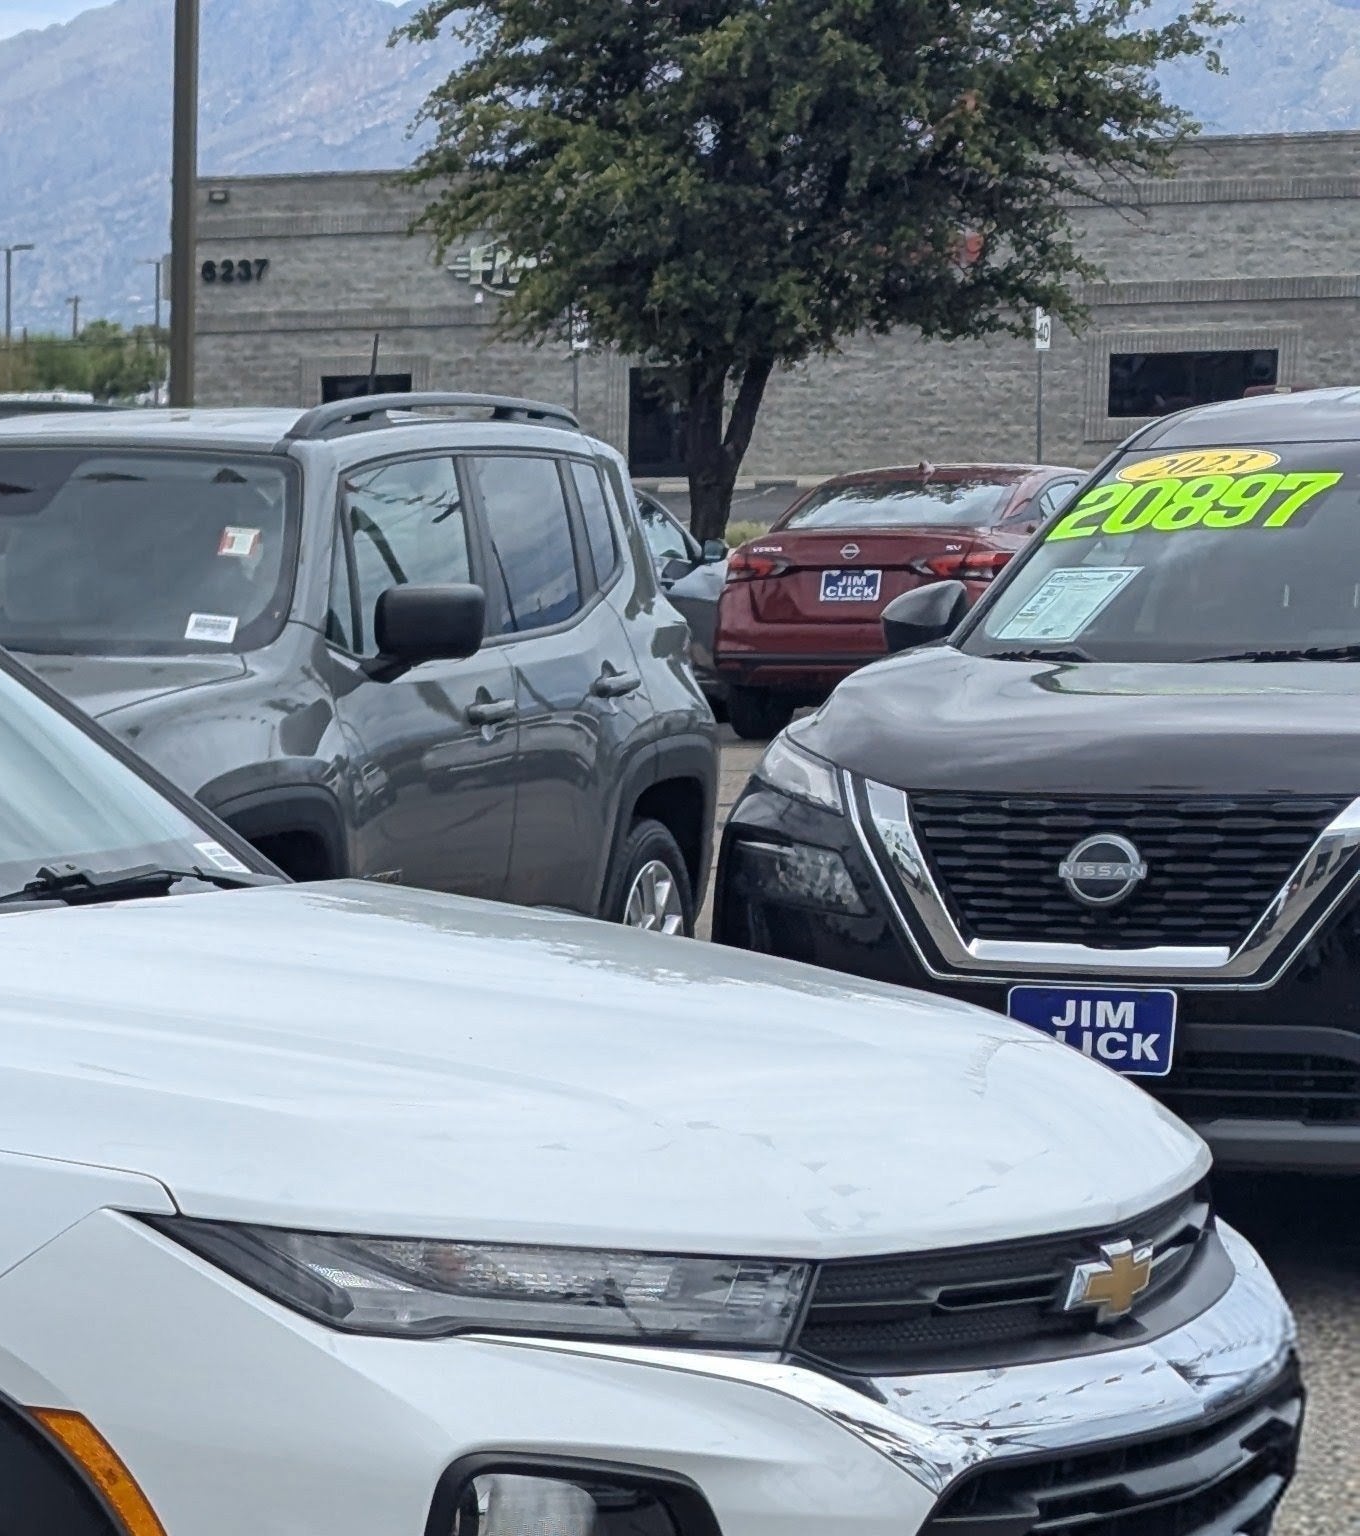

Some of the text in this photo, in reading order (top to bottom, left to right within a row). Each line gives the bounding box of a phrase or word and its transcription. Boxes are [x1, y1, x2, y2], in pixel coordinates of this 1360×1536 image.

[200, 257, 270, 283] 6237
[1147, 453, 1259, 477] 2023
[1045, 472, 1345, 542] 20897
[825, 585, 874, 597] CLICK
[837, 575, 867, 586] JIM
[1059, 864, 1146, 878] NISSAN
[1051, 999, 1136, 1029] JIM
